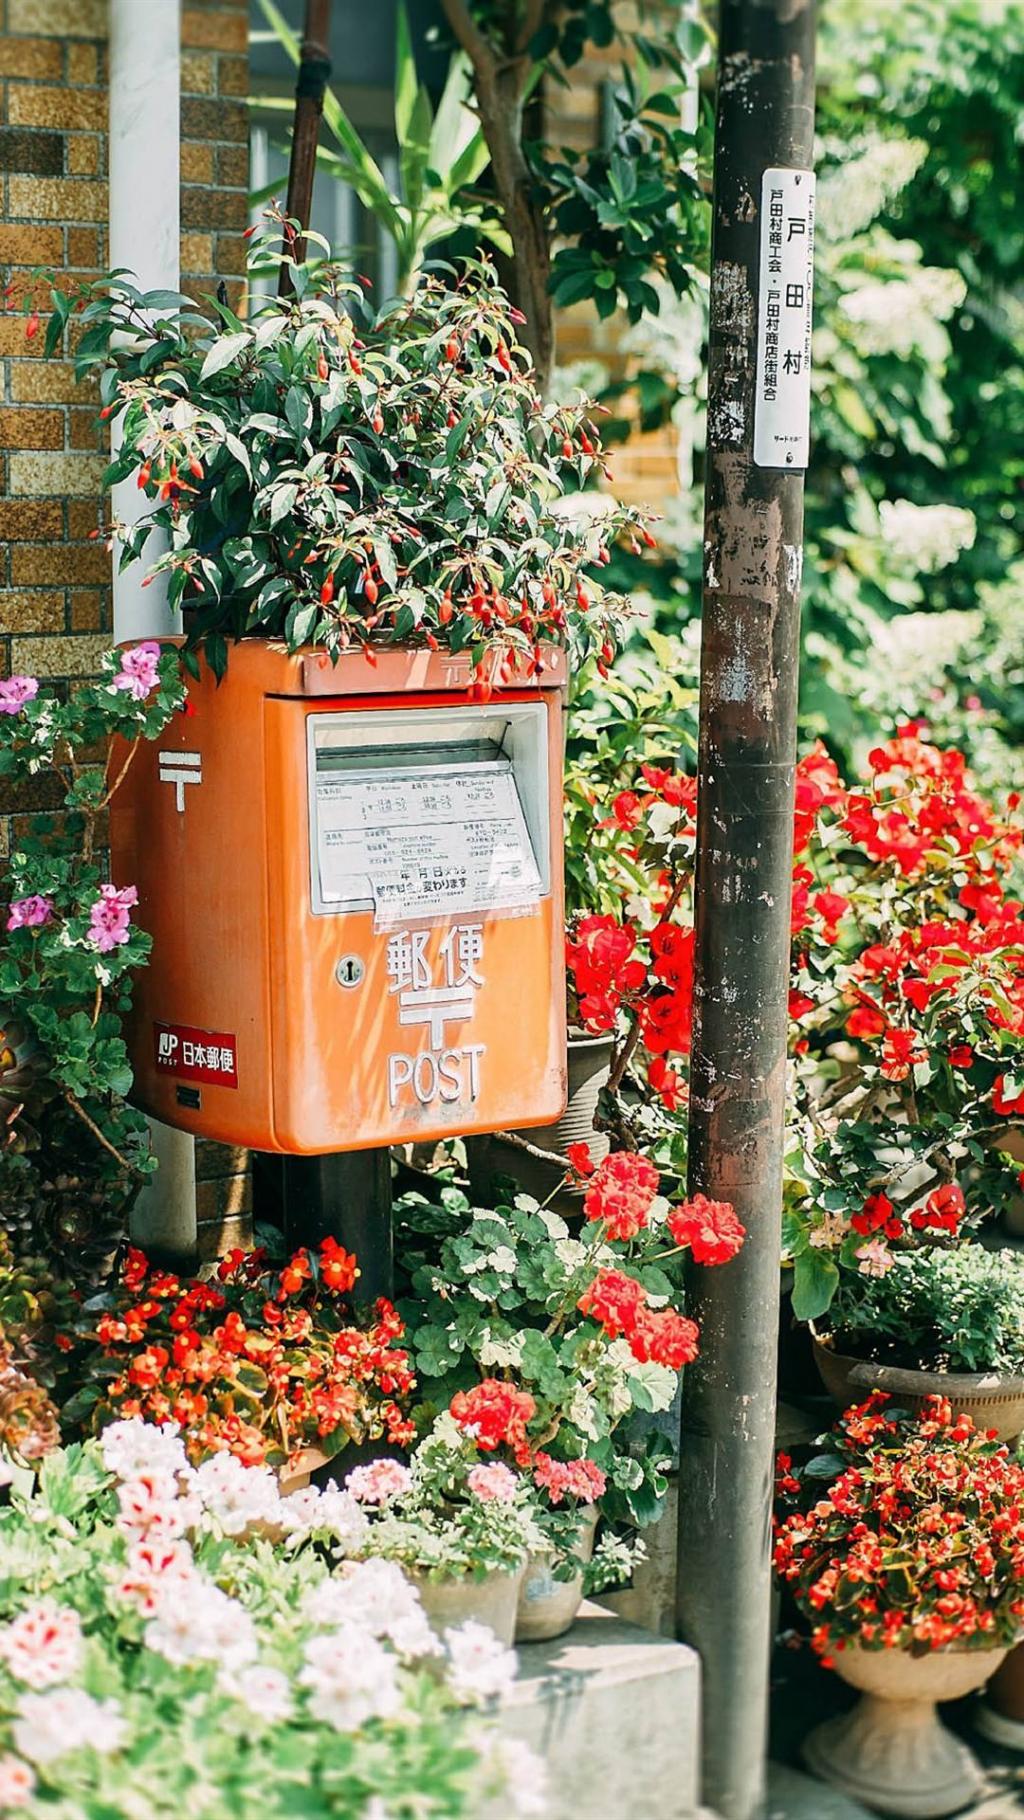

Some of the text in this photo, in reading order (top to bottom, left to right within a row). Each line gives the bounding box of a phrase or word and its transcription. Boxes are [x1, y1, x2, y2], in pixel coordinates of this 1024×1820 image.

[782, 217, 806, 375] 戸田村
[387, 924, 485, 993] 郵便
[158, 1057, 178, 1065] POST
[183, 1041, 234, 1074] 日本郵便
[388, 1044, 486, 1108] POST
